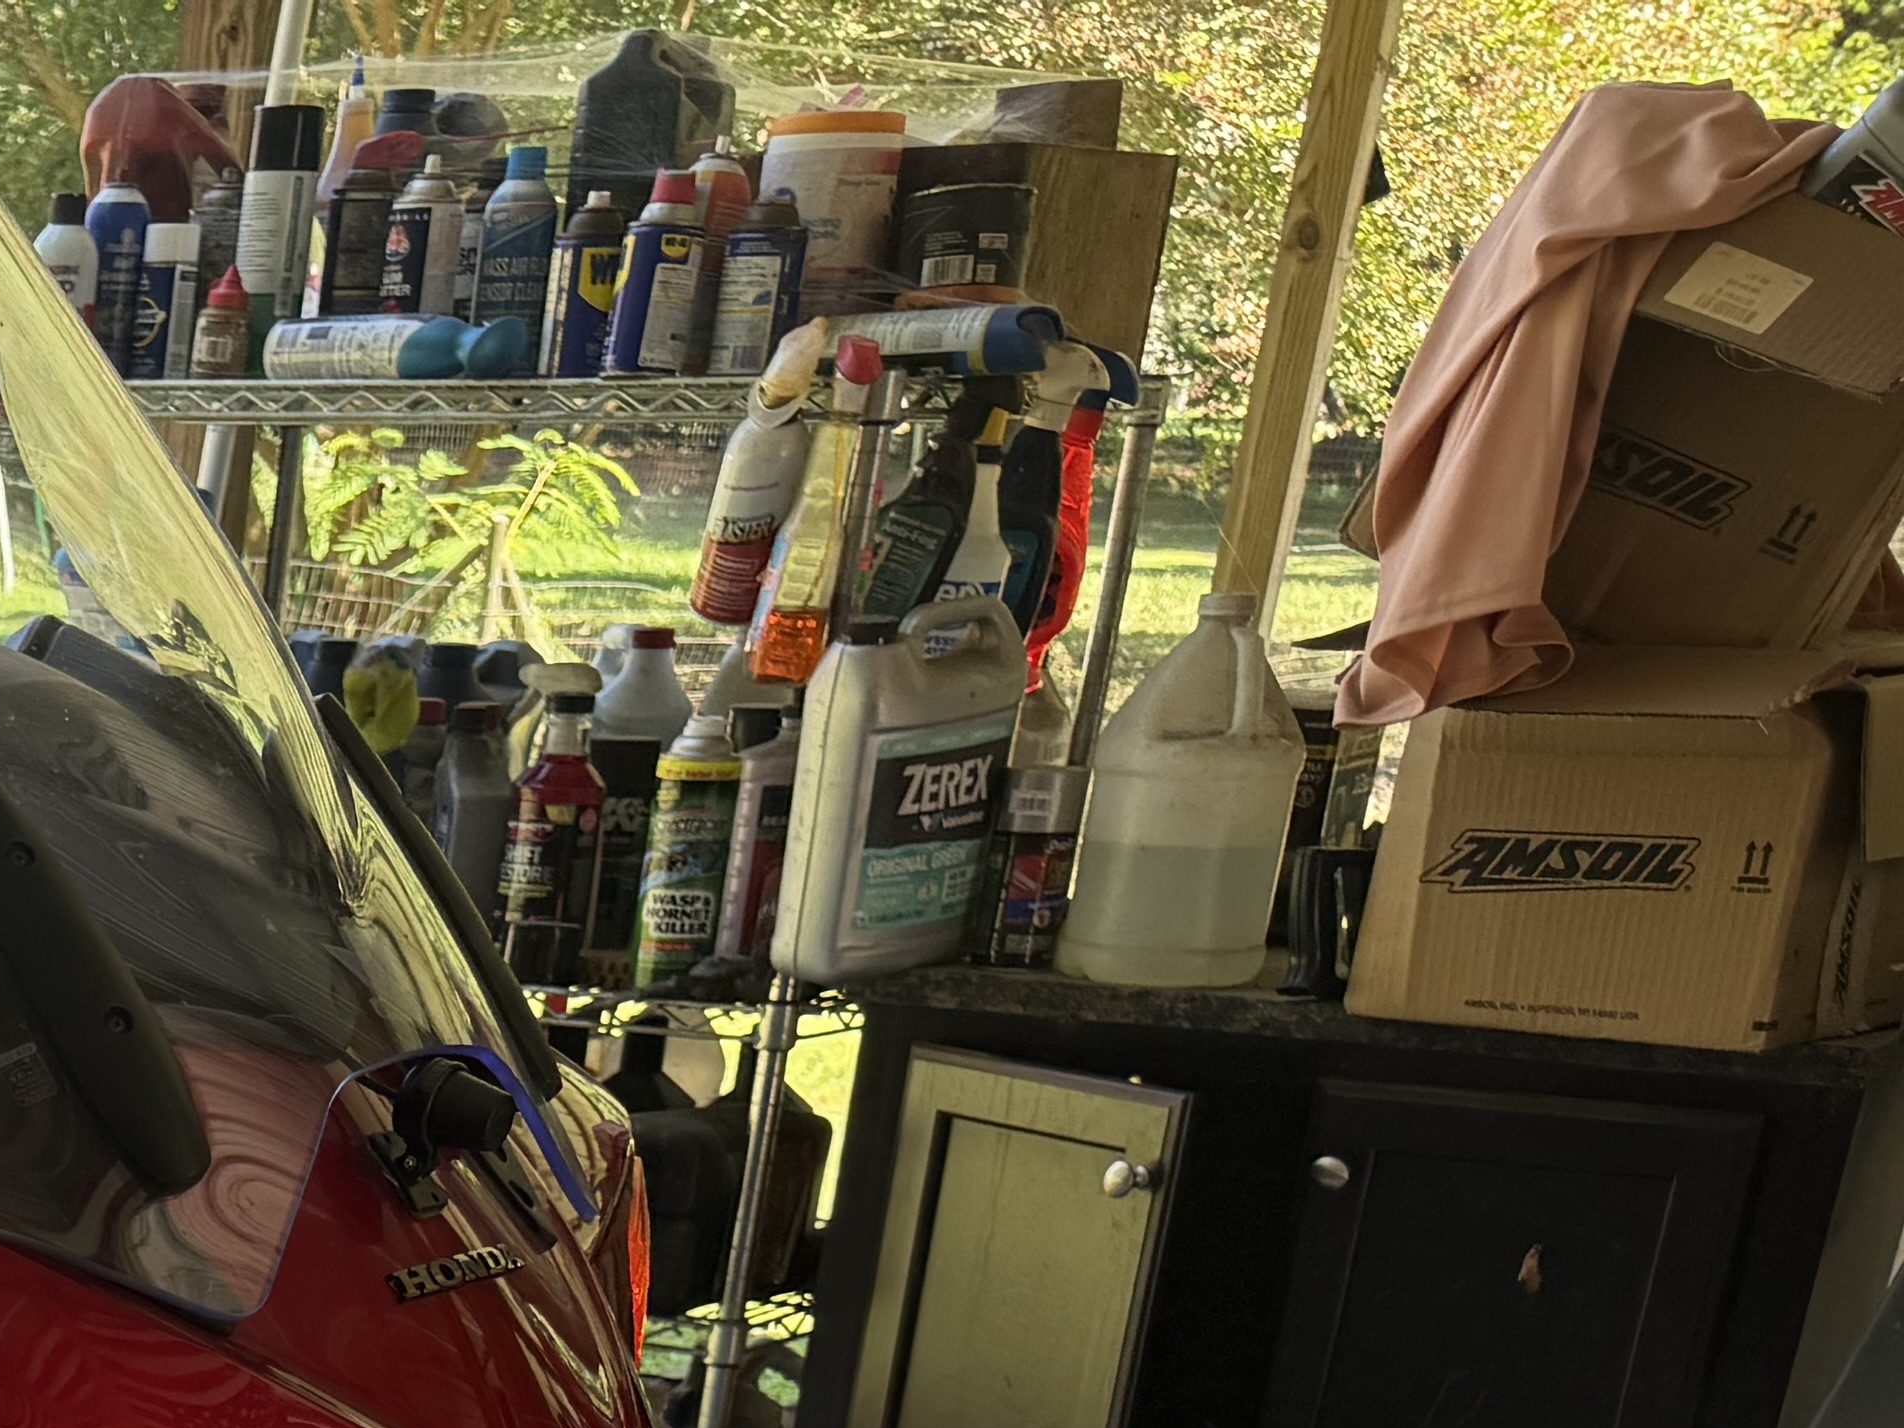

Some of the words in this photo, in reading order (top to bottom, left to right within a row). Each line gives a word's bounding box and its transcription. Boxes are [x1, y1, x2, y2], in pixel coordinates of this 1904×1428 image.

[897, 754, 993, 816] ZEREX
[1438, 835, 1688, 888] AMSOIL
[646, 908, 711, 921] HORNET
[652, 894, 701, 908] WASP
[654, 921, 708, 935] KILLER
[388, 1244, 526, 1301] HONDA
